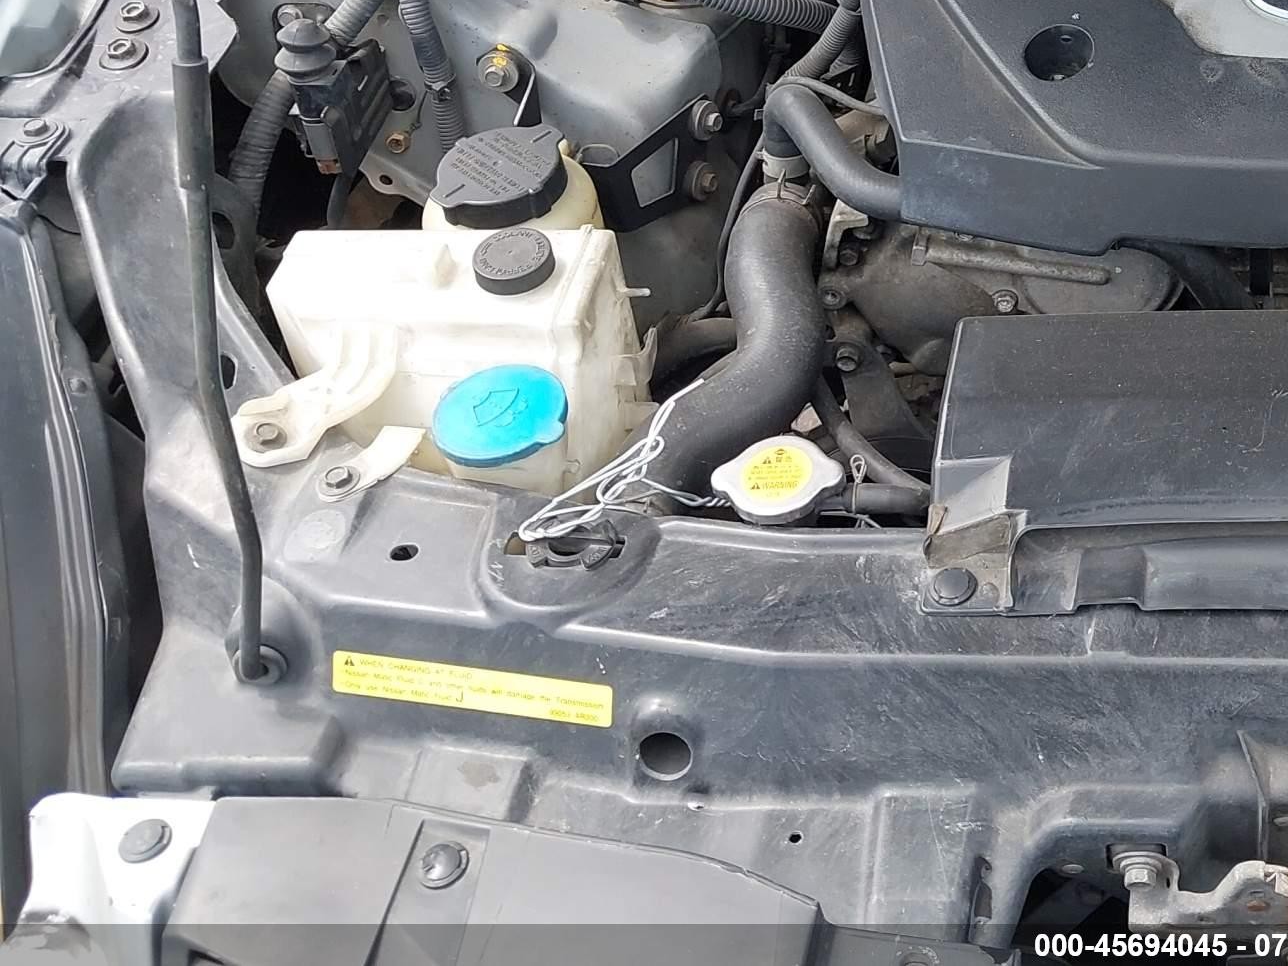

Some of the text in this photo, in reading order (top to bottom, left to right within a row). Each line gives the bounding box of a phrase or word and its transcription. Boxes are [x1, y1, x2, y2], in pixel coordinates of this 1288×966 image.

[762, 481, 798, 490] WARNING
[359, 658, 384, 669] WHEN
[387, 662, 431, 674] CHANGING
